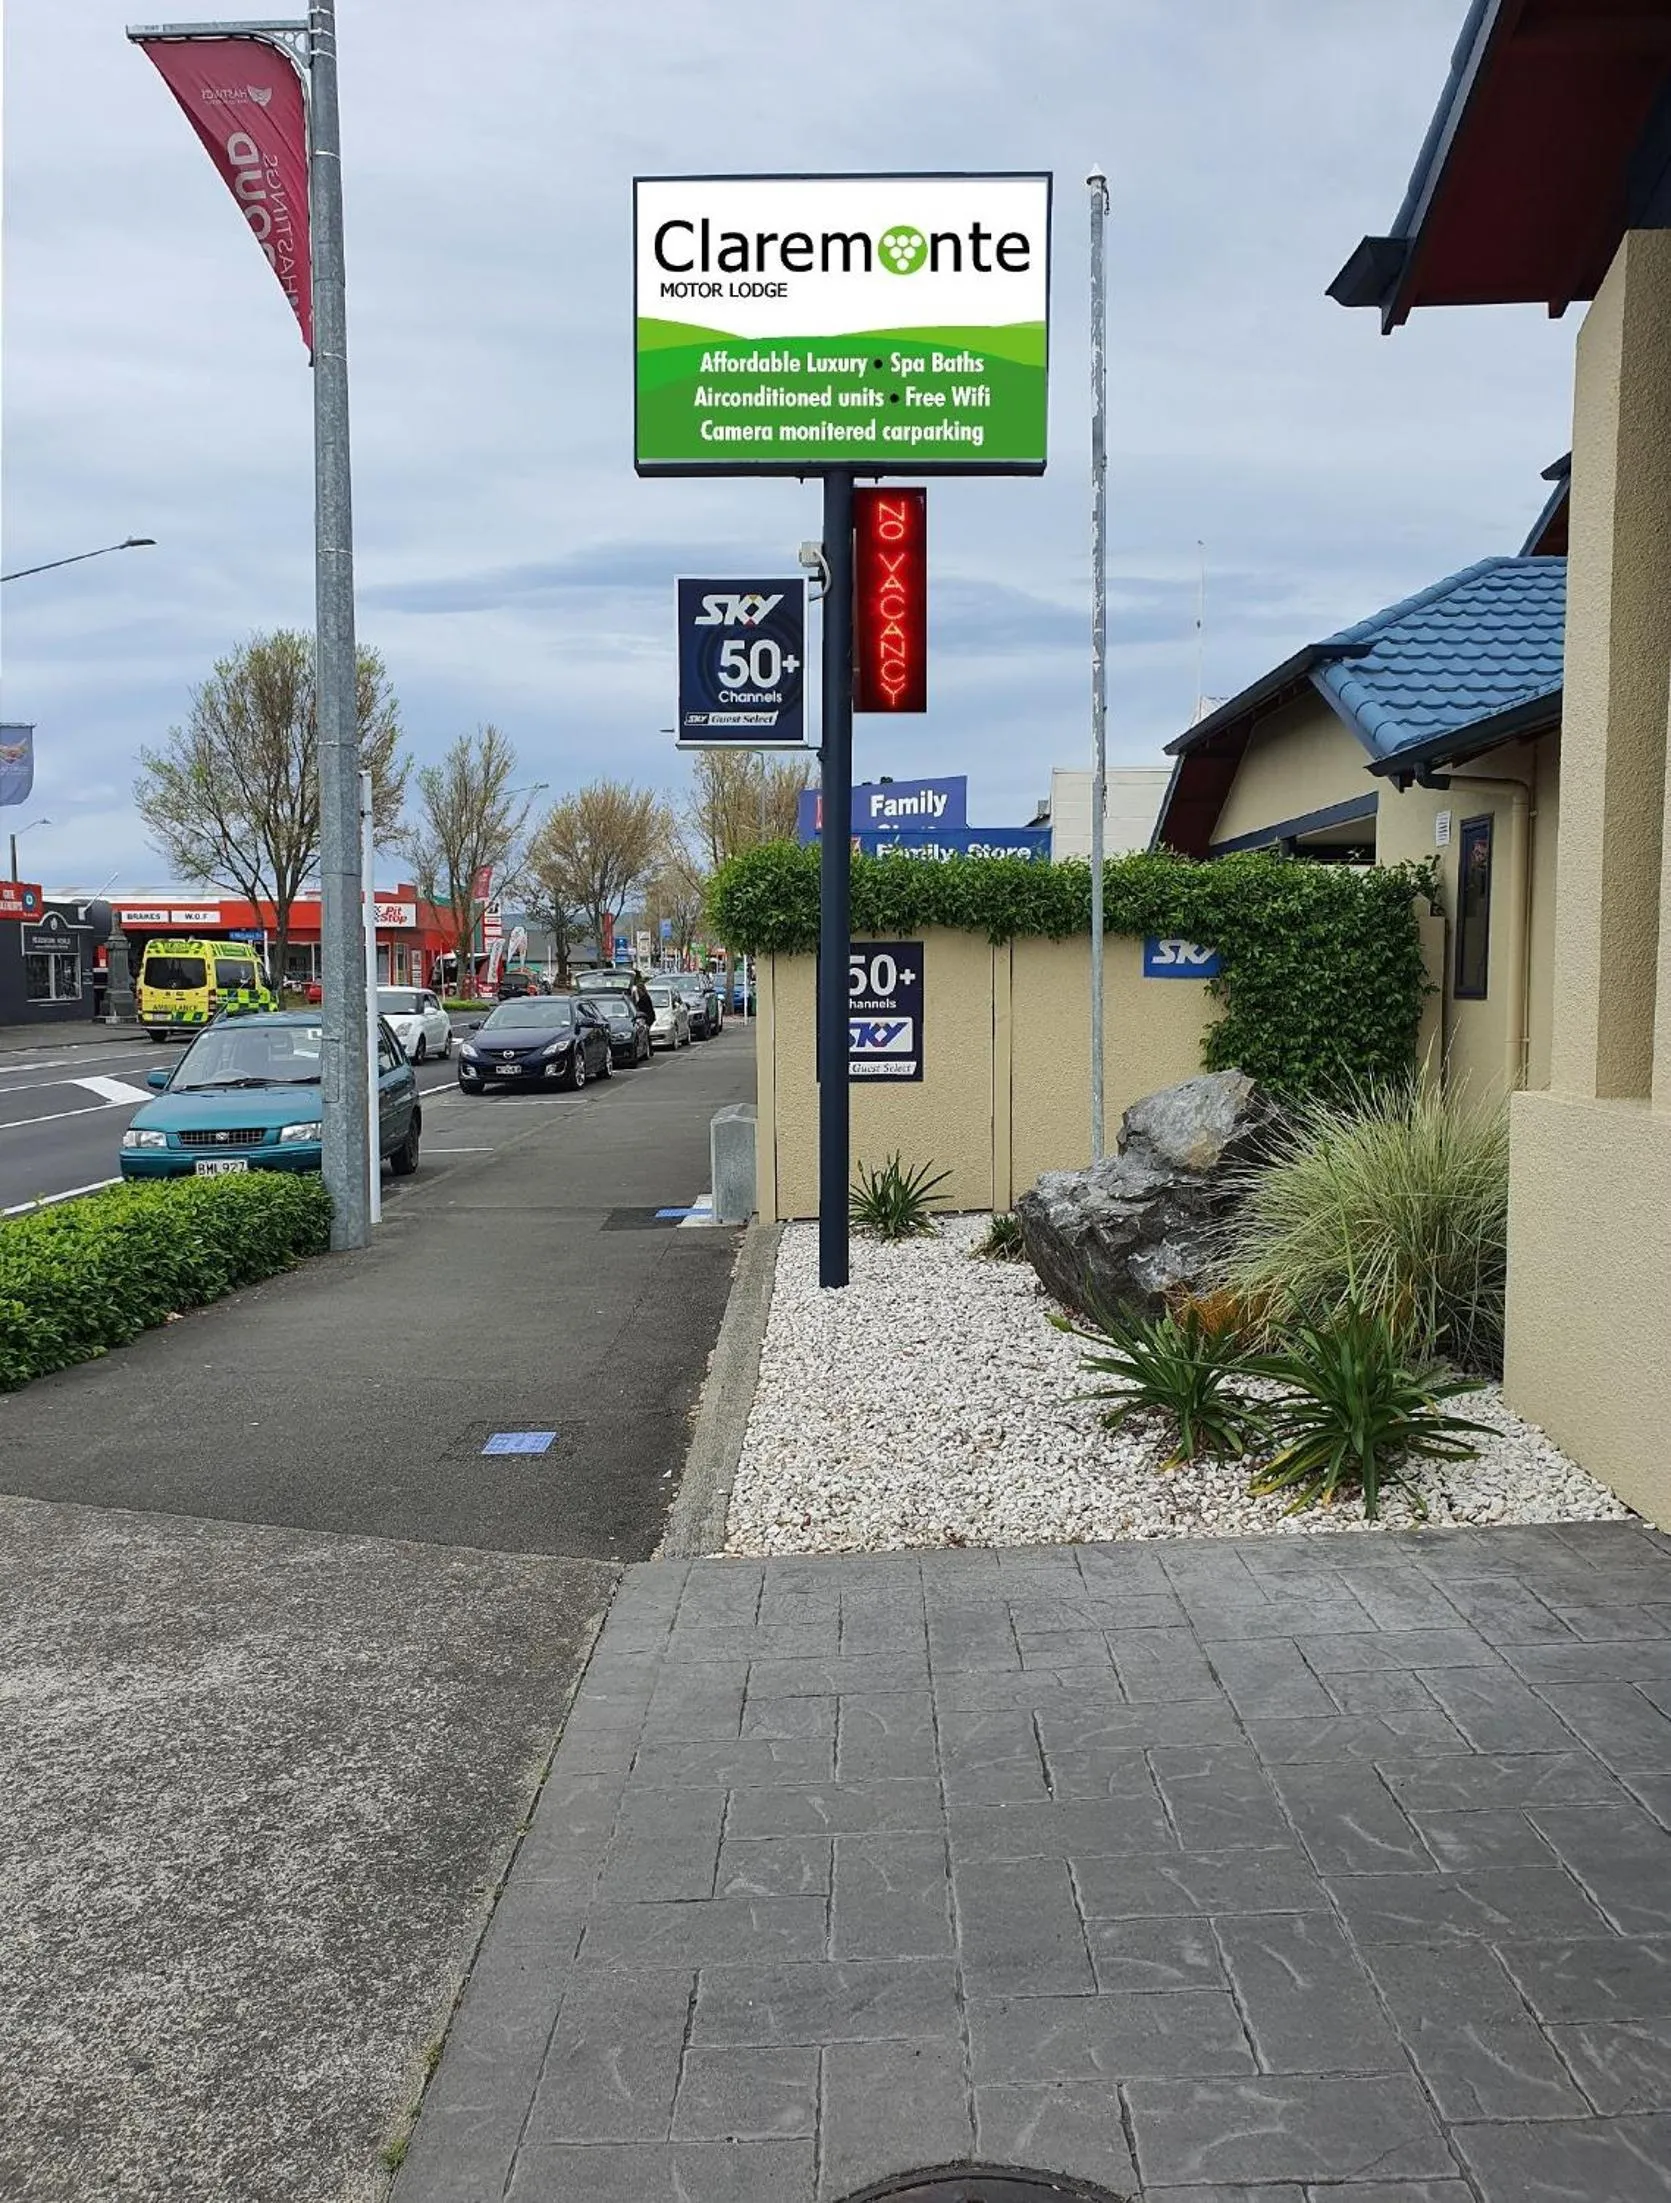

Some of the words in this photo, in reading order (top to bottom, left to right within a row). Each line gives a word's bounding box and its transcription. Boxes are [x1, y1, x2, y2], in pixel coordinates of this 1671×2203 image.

[660, 282, 724, 299] MOTOR
[729, 282, 788, 298] LODGE
[700, 351, 801, 374] Affordable
[807, 351, 868, 378] Luxury
[890, 352, 925, 377] Spa
[931, 352, 985, 374] Baths
[694, 385, 834, 408] Airconditioned
[838, 386, 884, 408] units
[905, 387, 946, 407] Free
[952, 385, 991, 407] Wifi
[700, 419, 773, 442] Camera
[779, 420, 877, 441] monitered
[882, 419, 985, 447] carparking
[878, 501, 905, 540] NO
[694, 593, 785, 626] SKY
[879, 552, 906, 707] VACANCY
[717, 639, 800, 689] 50+
[718, 689, 783, 704] Channels
[711, 715, 741, 724] Guest
[743, 714, 774, 724] Select
[870, 789, 948, 818] Family
[127, 913, 161, 921] BRAKES
[380, 913, 408, 925] Stop
[385, 906, 403, 917] Pit
[849, 998, 897, 1010] hannels
[883, 1063, 912, 1073] Select
